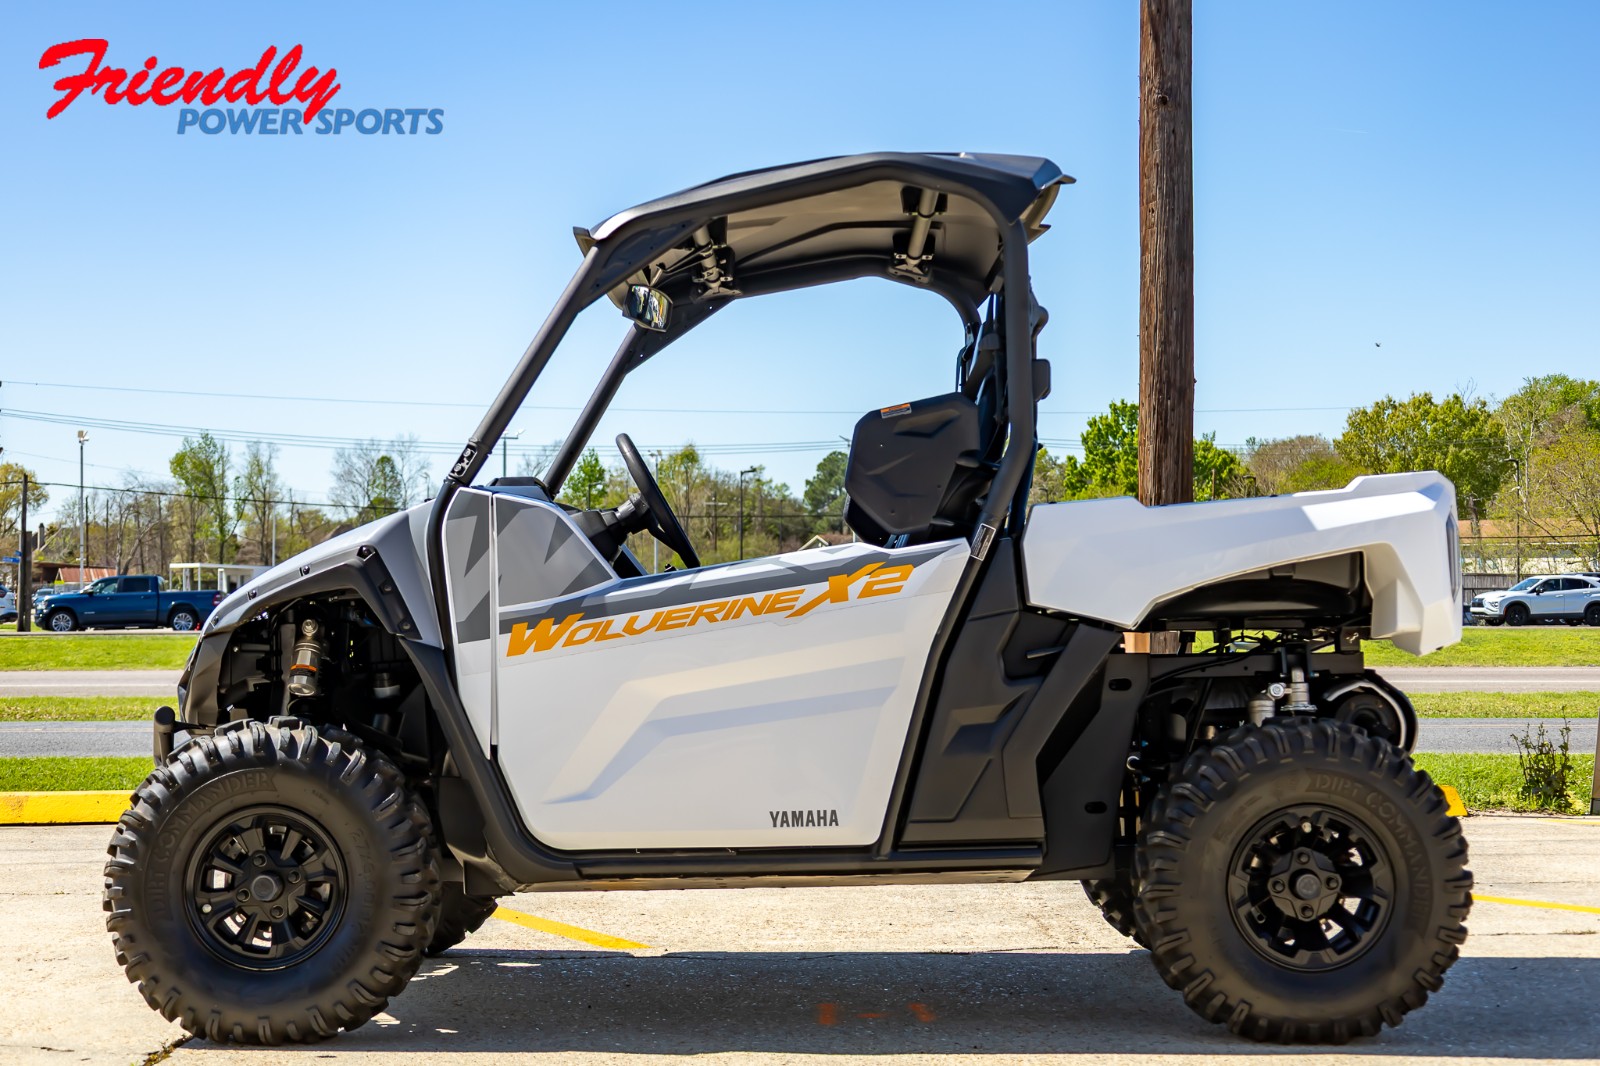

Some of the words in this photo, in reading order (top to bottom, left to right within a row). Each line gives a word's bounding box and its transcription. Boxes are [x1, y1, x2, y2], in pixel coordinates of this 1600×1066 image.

[506, 588, 805, 658] WOLVERINE
[784, 561, 915, 619] X2
[154, 771, 271, 863] COMMANDER
[769, 809, 839, 828] YAMAHA
[1315, 773, 1364, 795] DIRT
[1365, 791, 1431, 923] COMMANDER
